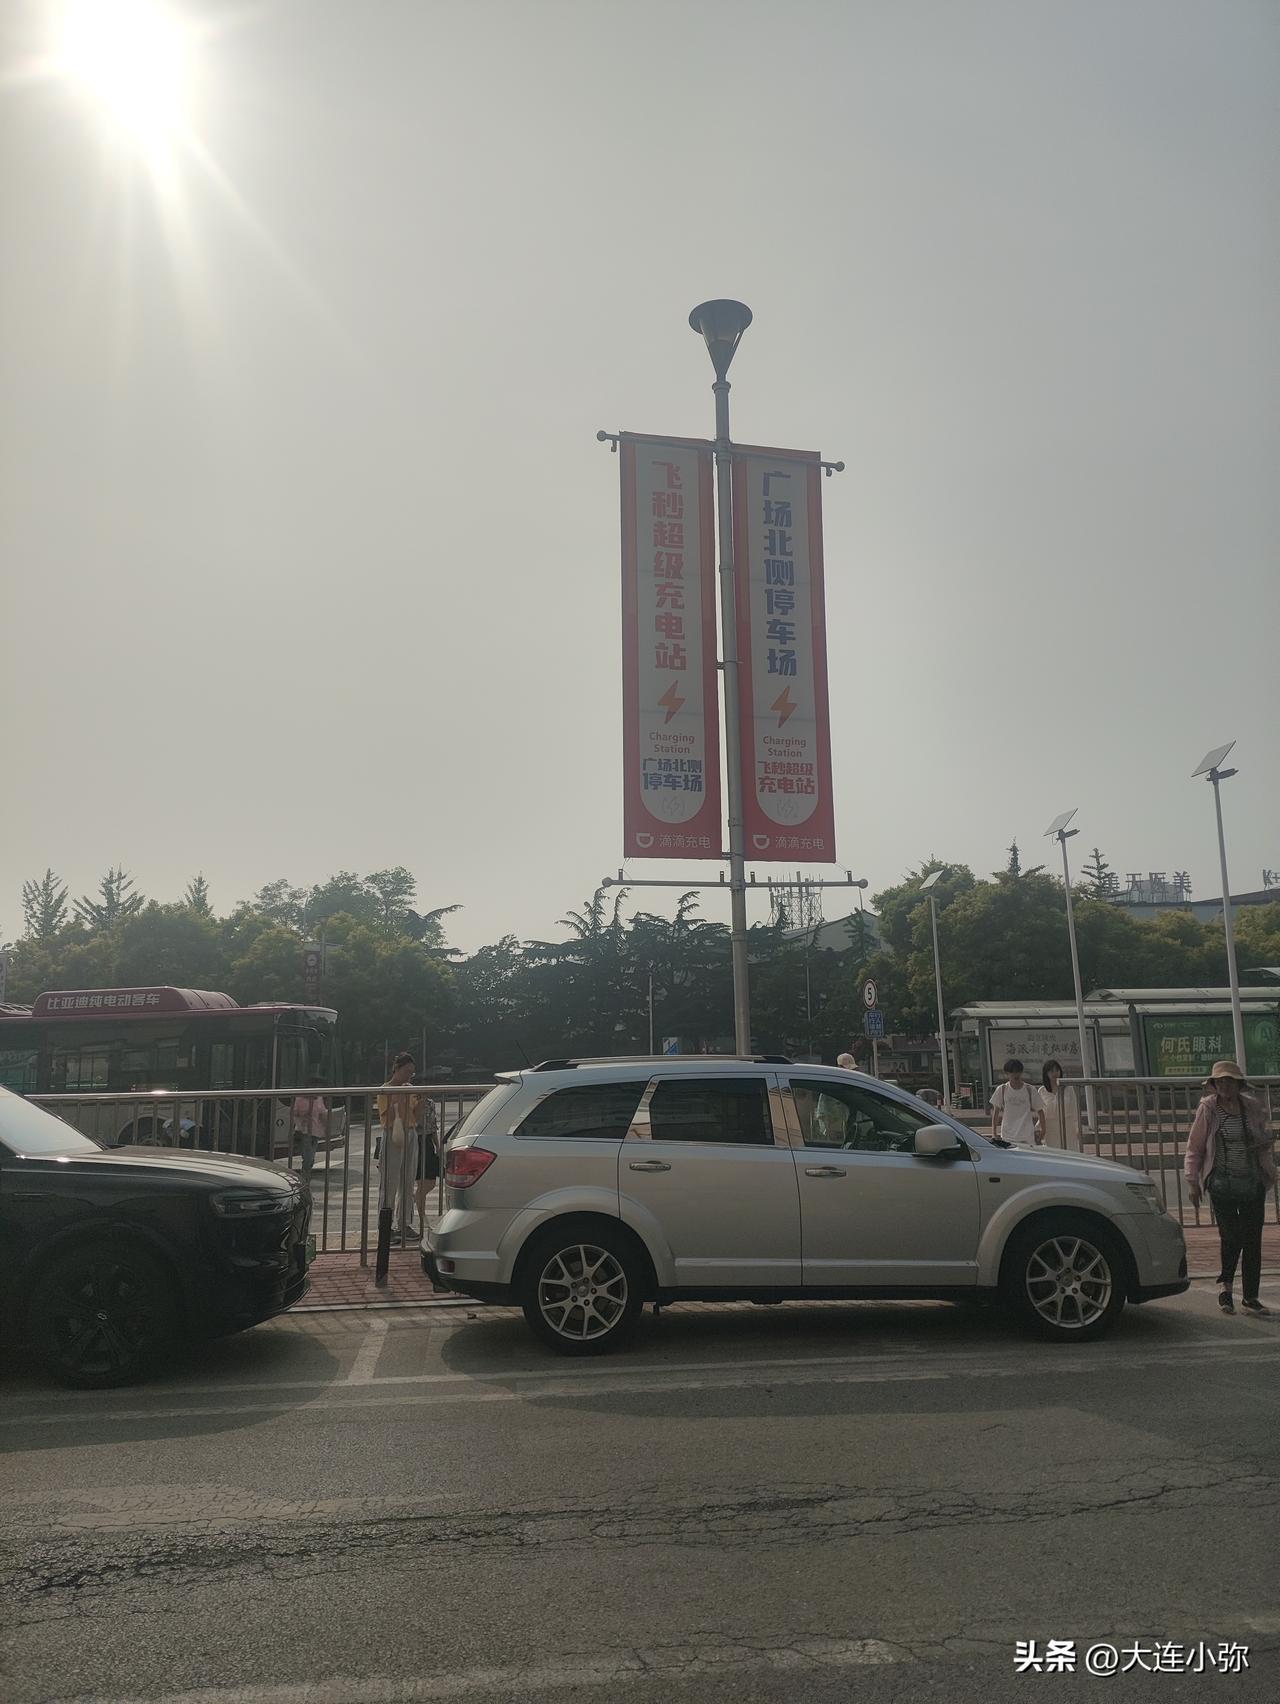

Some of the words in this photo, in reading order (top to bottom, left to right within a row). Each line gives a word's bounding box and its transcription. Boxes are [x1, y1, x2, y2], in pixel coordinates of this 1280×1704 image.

[651, 460, 688, 671] 飞秒超级充电站
[762, 470, 798, 677] 广场北侧停车场
[649, 732, 695, 744] Charging
[763, 736, 807, 748] Charging
[654, 744, 690, 754] Station
[768, 748, 802, 758] Station
[642, 758, 702, 773] 广场北侧
[757, 761, 814, 776] 飞秒超级
[643, 773, 703, 793] 停车场
[758, 777, 816, 794] 充电站
[658, 834, 711, 849] 滴滴充电
[775, 836, 825, 850] 滴滴充电
[47, 992, 161, 1010] 比亚迪纯电动客车
[867, 987, 873, 1001] 5
[1160, 1035, 1222, 1053] 何氏眼科
